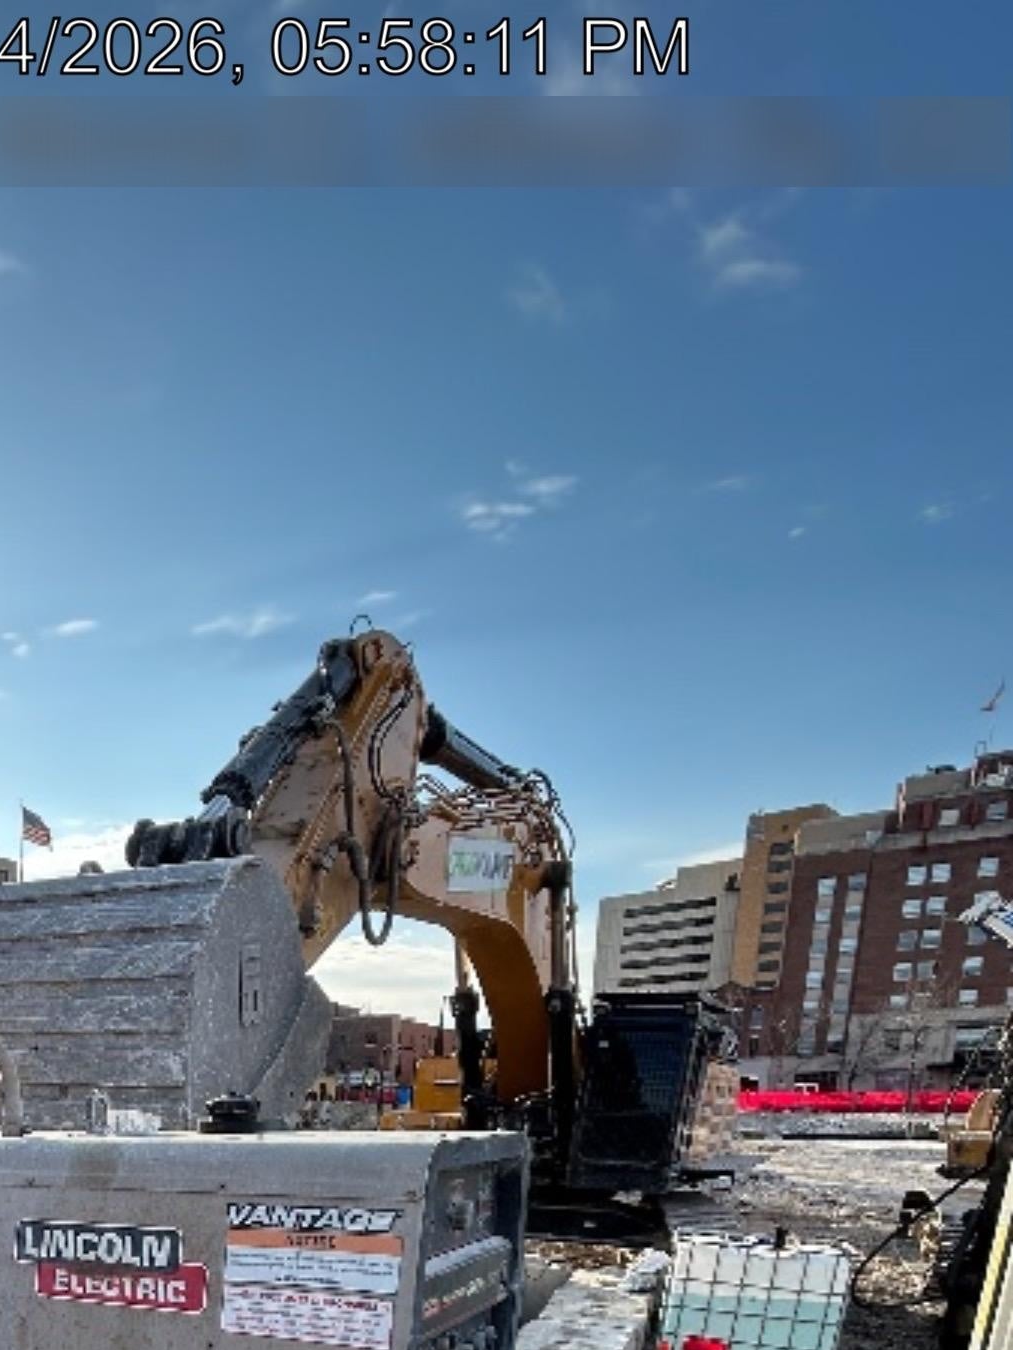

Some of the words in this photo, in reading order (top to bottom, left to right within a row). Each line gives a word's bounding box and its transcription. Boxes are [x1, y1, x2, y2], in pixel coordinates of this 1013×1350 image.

[227, 1204, 399, 1232] VANTAGE
[23, 1225, 172, 1268] LINCOLN
[52, 1267, 187, 1304] ELECTRIC
